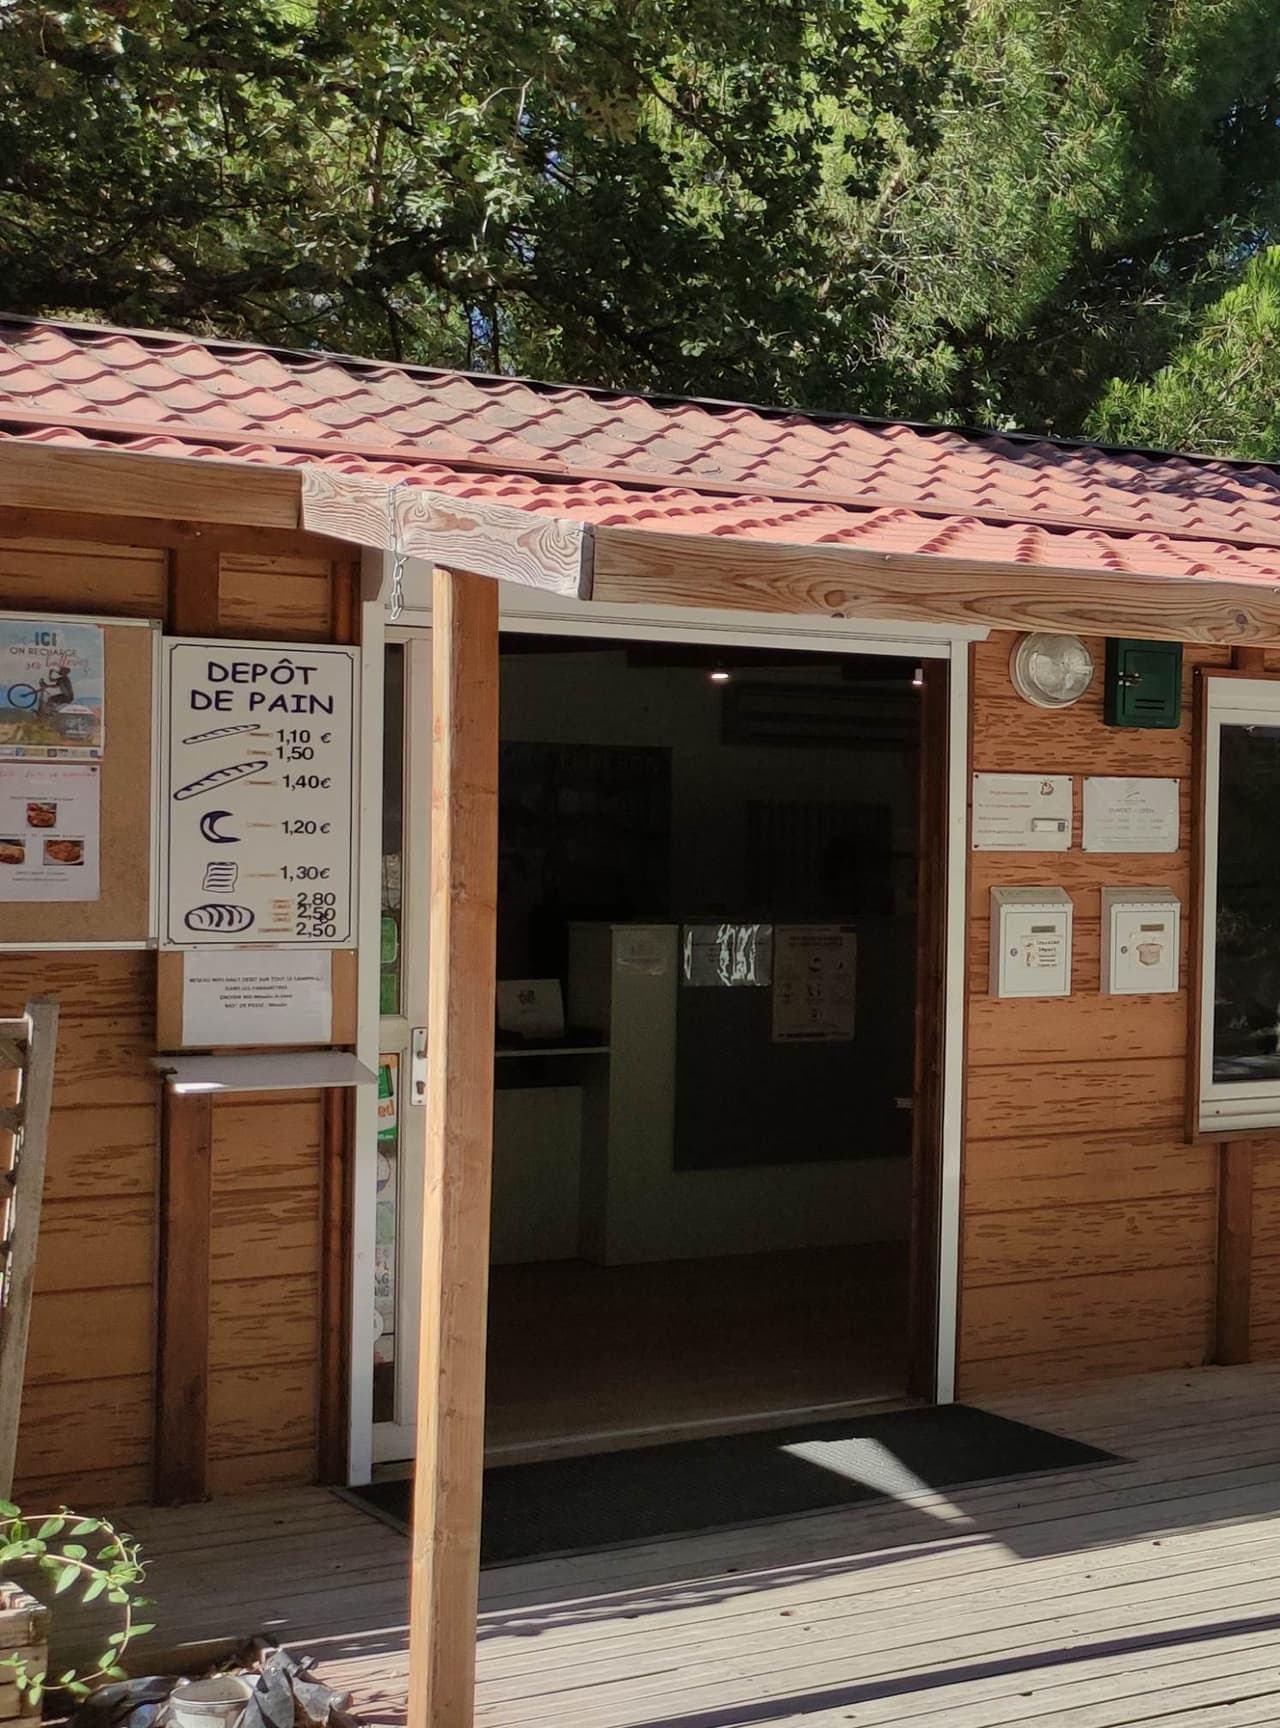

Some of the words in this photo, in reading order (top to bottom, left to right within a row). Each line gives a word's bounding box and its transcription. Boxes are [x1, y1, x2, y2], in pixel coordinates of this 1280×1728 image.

[35, 631, 57, 647] ICI
[207, 658, 318, 685] DEPÔT
[190, 689, 234, 711] DE
[249, 692, 334, 714] PAIN
[276, 729, 311, 745] 1,10
[320, 732, 332, 744] €
[275, 746, 314, 762] 1,50
[281, 820, 317, 836] 1,20
[297, 892, 336, 909] 2,80
[297, 907, 336, 921] 2,50
[296, 922, 336, 938] 2,50
